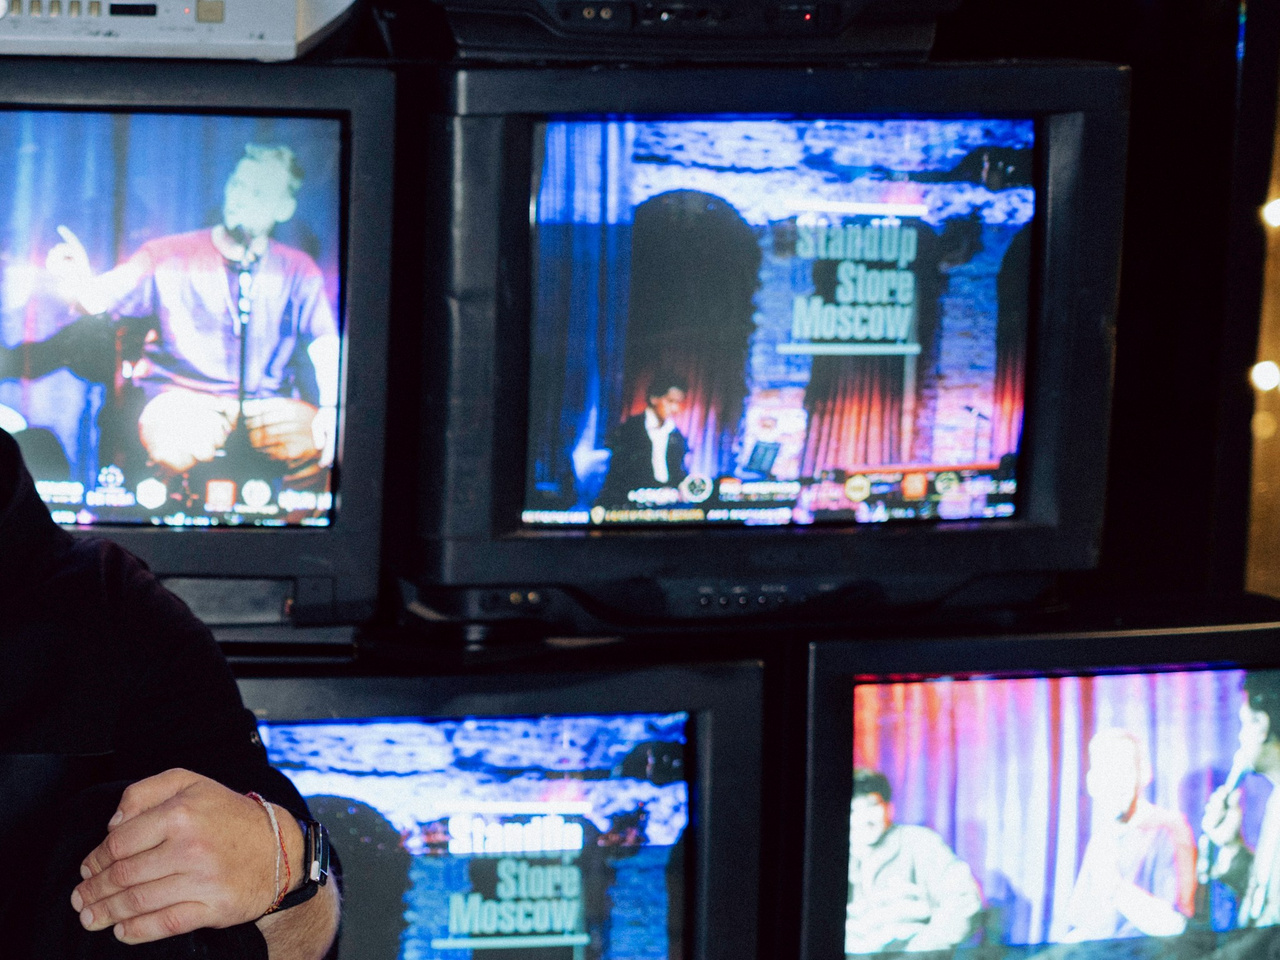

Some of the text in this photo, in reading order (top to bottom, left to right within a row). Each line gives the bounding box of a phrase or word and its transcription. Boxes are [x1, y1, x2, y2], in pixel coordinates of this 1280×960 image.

[836, 260, 916, 304] Store
[792, 295, 913, 340] Moscow
[496, 859, 582, 900] Store
[448, 892, 581, 935] Moscow
